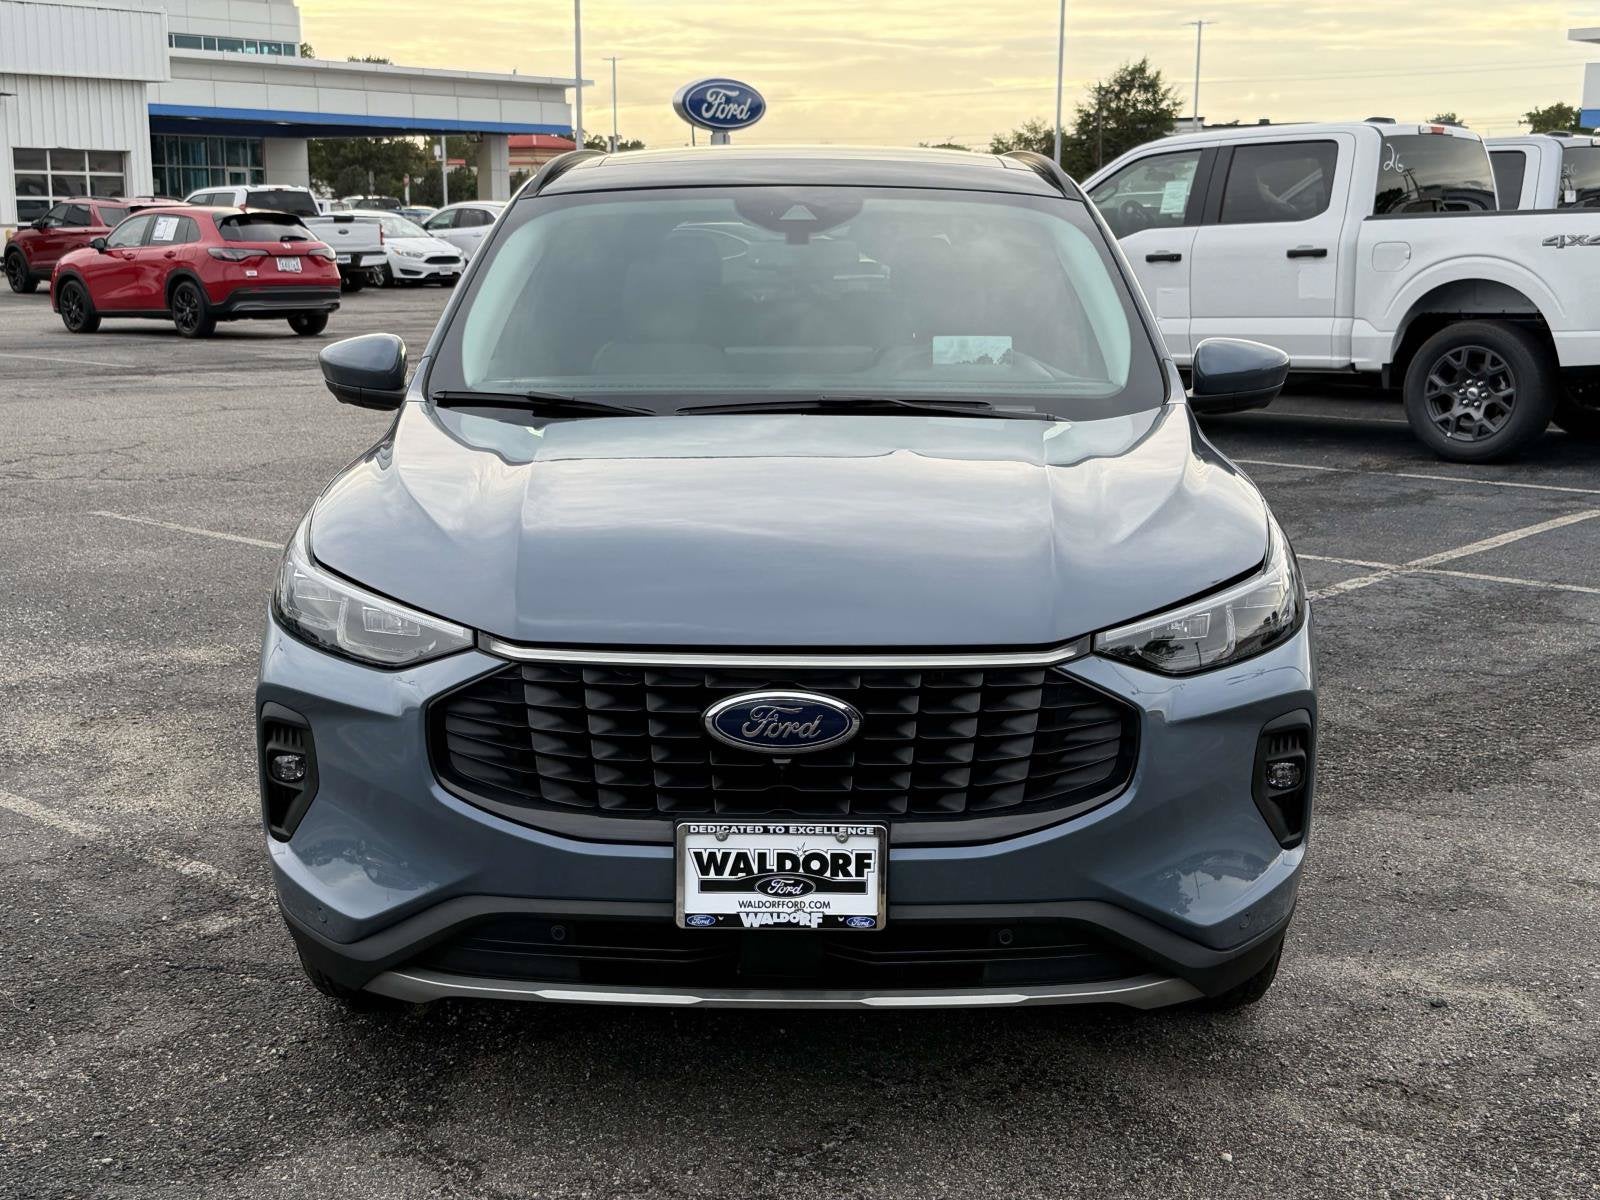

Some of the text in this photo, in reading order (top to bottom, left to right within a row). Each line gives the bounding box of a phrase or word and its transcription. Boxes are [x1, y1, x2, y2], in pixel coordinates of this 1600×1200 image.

[701, 88, 752, 120] Ford
[1383, 143, 1404, 172] 26
[741, 705, 824, 739] Ford
[689, 825, 875, 835] DEDICATED TO EXCELLENCE
[692, 851, 873, 878] WALDORF
[767, 878, 804, 895] Ford
[738, 900, 831, 910] WALDORFFORD.COM
[692, 917, 711, 926] Ford
[739, 912, 824, 928] WALDORF
[851, 918, 870, 927] Ford
